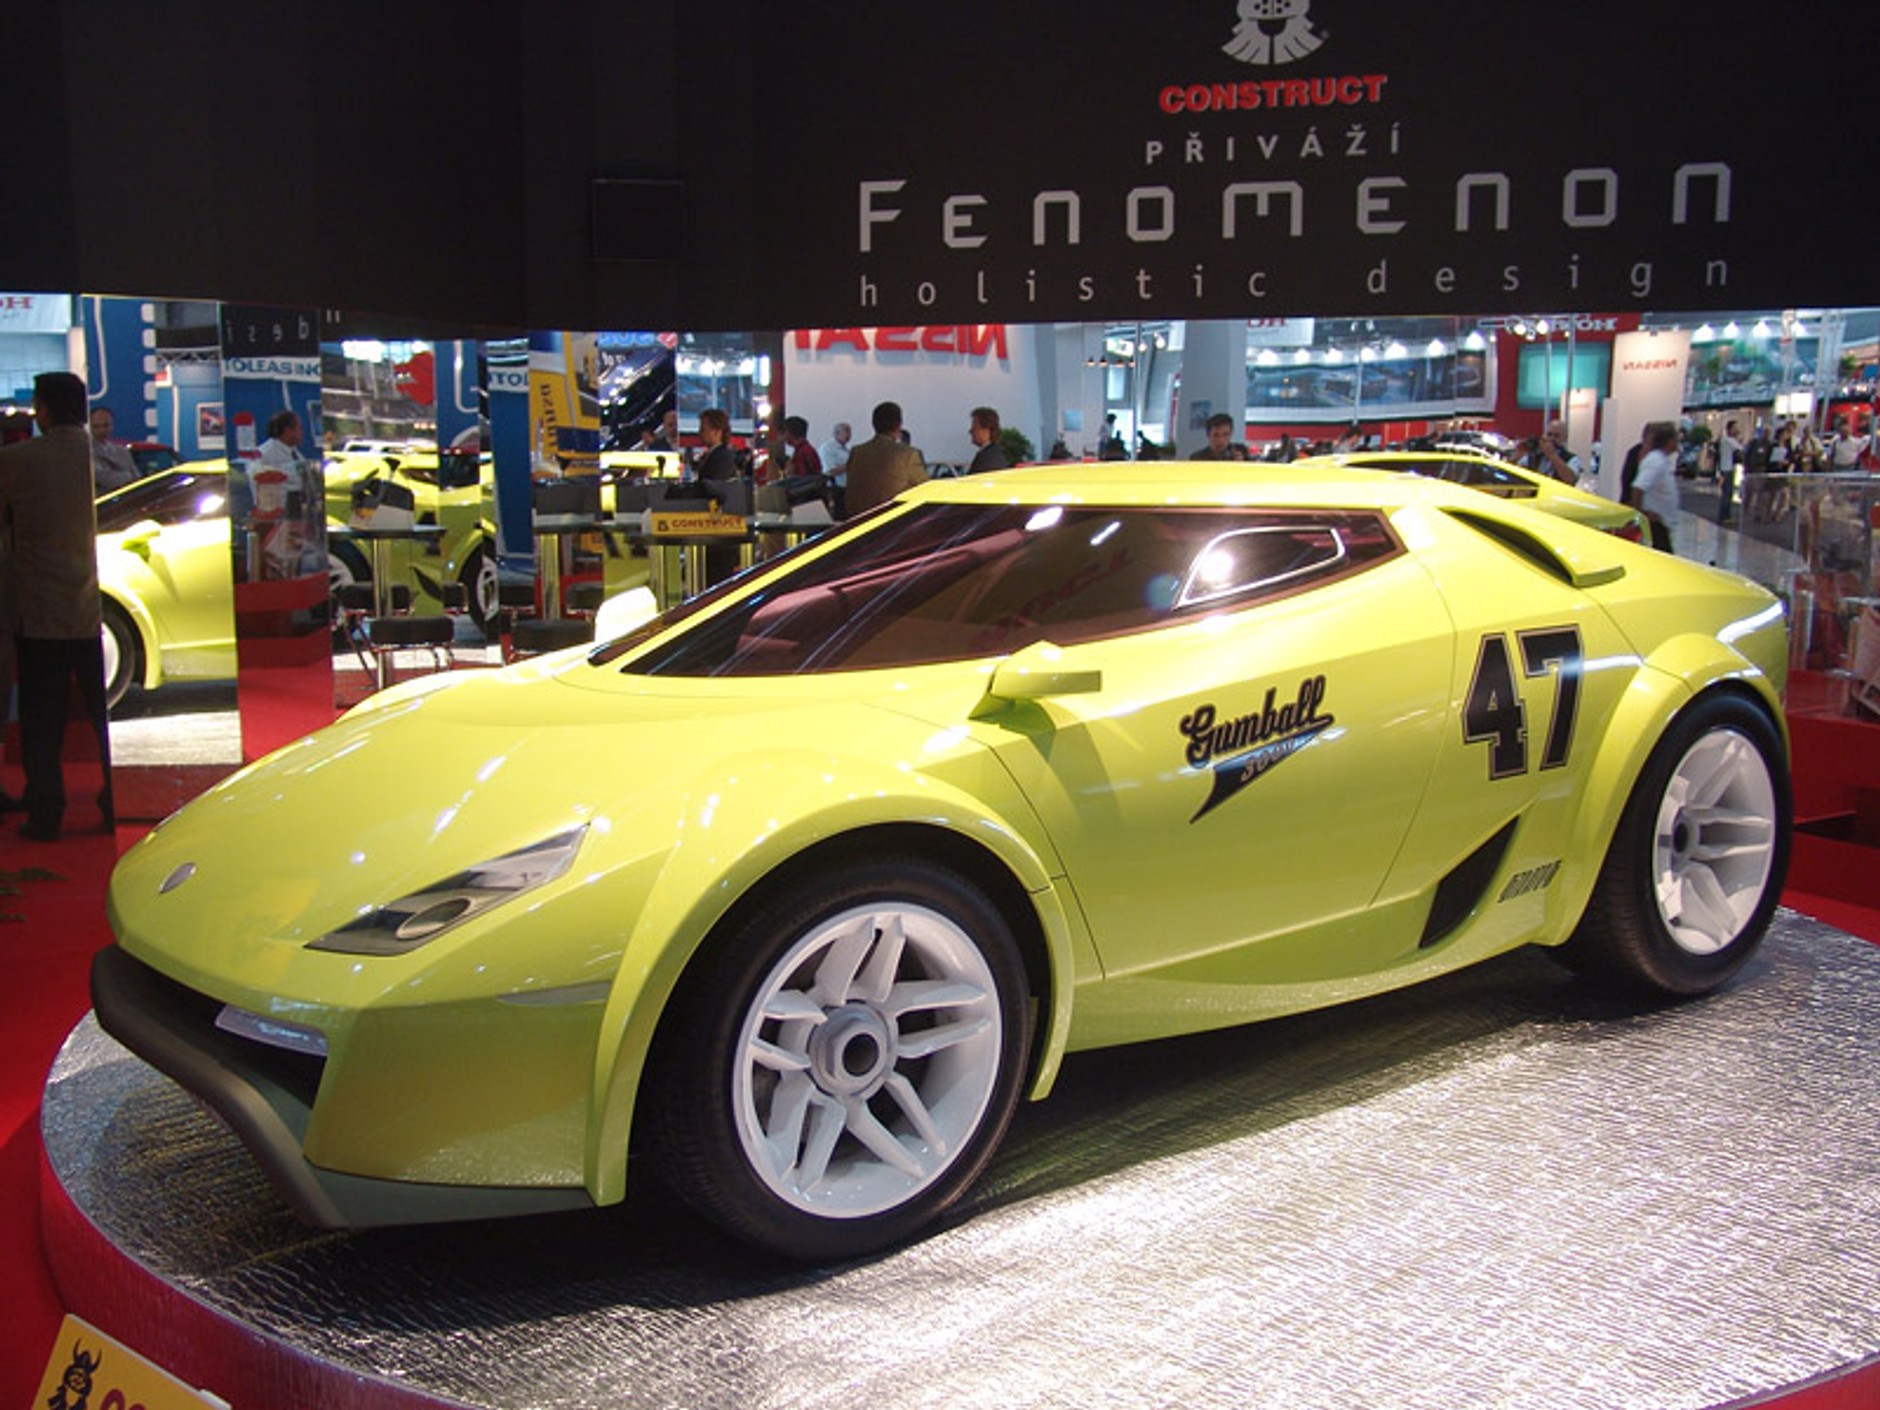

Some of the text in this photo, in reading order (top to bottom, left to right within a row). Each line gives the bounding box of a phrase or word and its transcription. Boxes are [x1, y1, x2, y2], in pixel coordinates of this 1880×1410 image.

[1158, 74, 1388, 114] CONSTRUCT
[1145, 121, 1402, 165] PŘIVÁŽÍ
[860, 253, 1728, 306] holistic design
[1180, 674, 1335, 769] Gumball
[1461, 623, 1585, 782] 47
